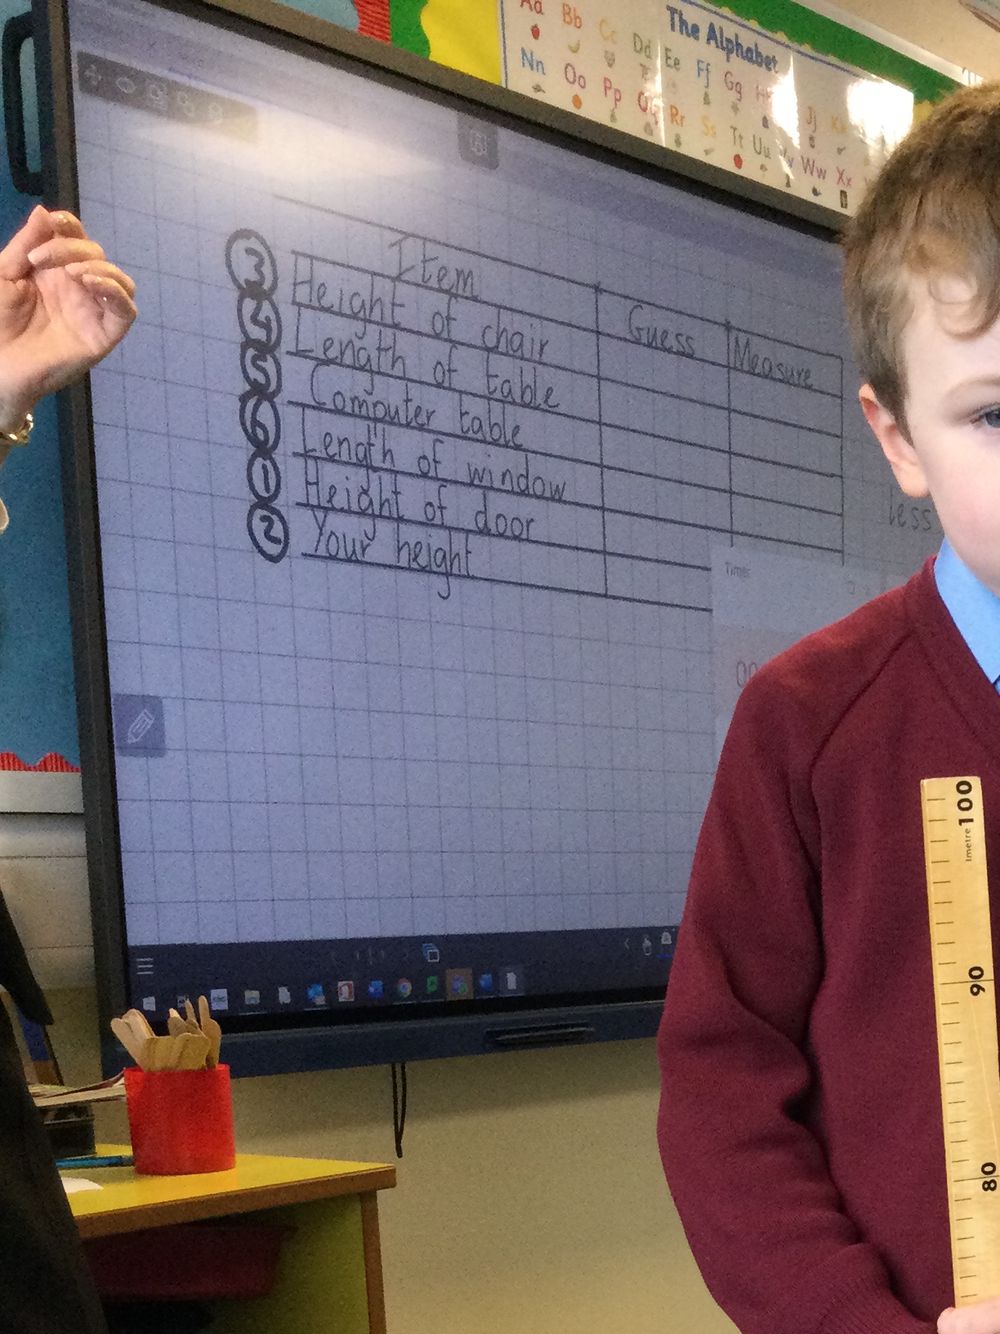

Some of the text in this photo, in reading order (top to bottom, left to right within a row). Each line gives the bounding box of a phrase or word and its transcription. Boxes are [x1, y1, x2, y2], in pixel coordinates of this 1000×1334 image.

[664, 47, 681, 71] Ee
[724, 71, 742, 102] Gg
[666, 5, 778, 73] The Alphabet
[521, 47, 546, 75] Nn
[670, 105, 685, 127] Rr
[800, 155, 827, 180] Ww
[291, 253, 405, 340] Height
[432, 296, 457, 342] of
[481, 307, 550, 360] chair
[628, 304, 813, 388] Guess Measure
[295, 303, 406, 394] Length
[433, 342, 458, 388] of
[486, 350, 560, 408] table
[310, 362, 436, 438] Computer
[459, 387, 523, 448] table
[301, 406, 395, 498] Length
[418, 439, 444, 480] of
[467, 453, 568, 500] window
[303, 457, 405, 541] Height
[424, 485, 448, 528] of
[474, 490, 536, 540] door
[311, 507, 374, 562] Your
[395, 528, 473, 601] height
[956, 780, 974, 826] 100
[968, 966, 986, 997] 90
[981, 1162, 998, 1191] 80
